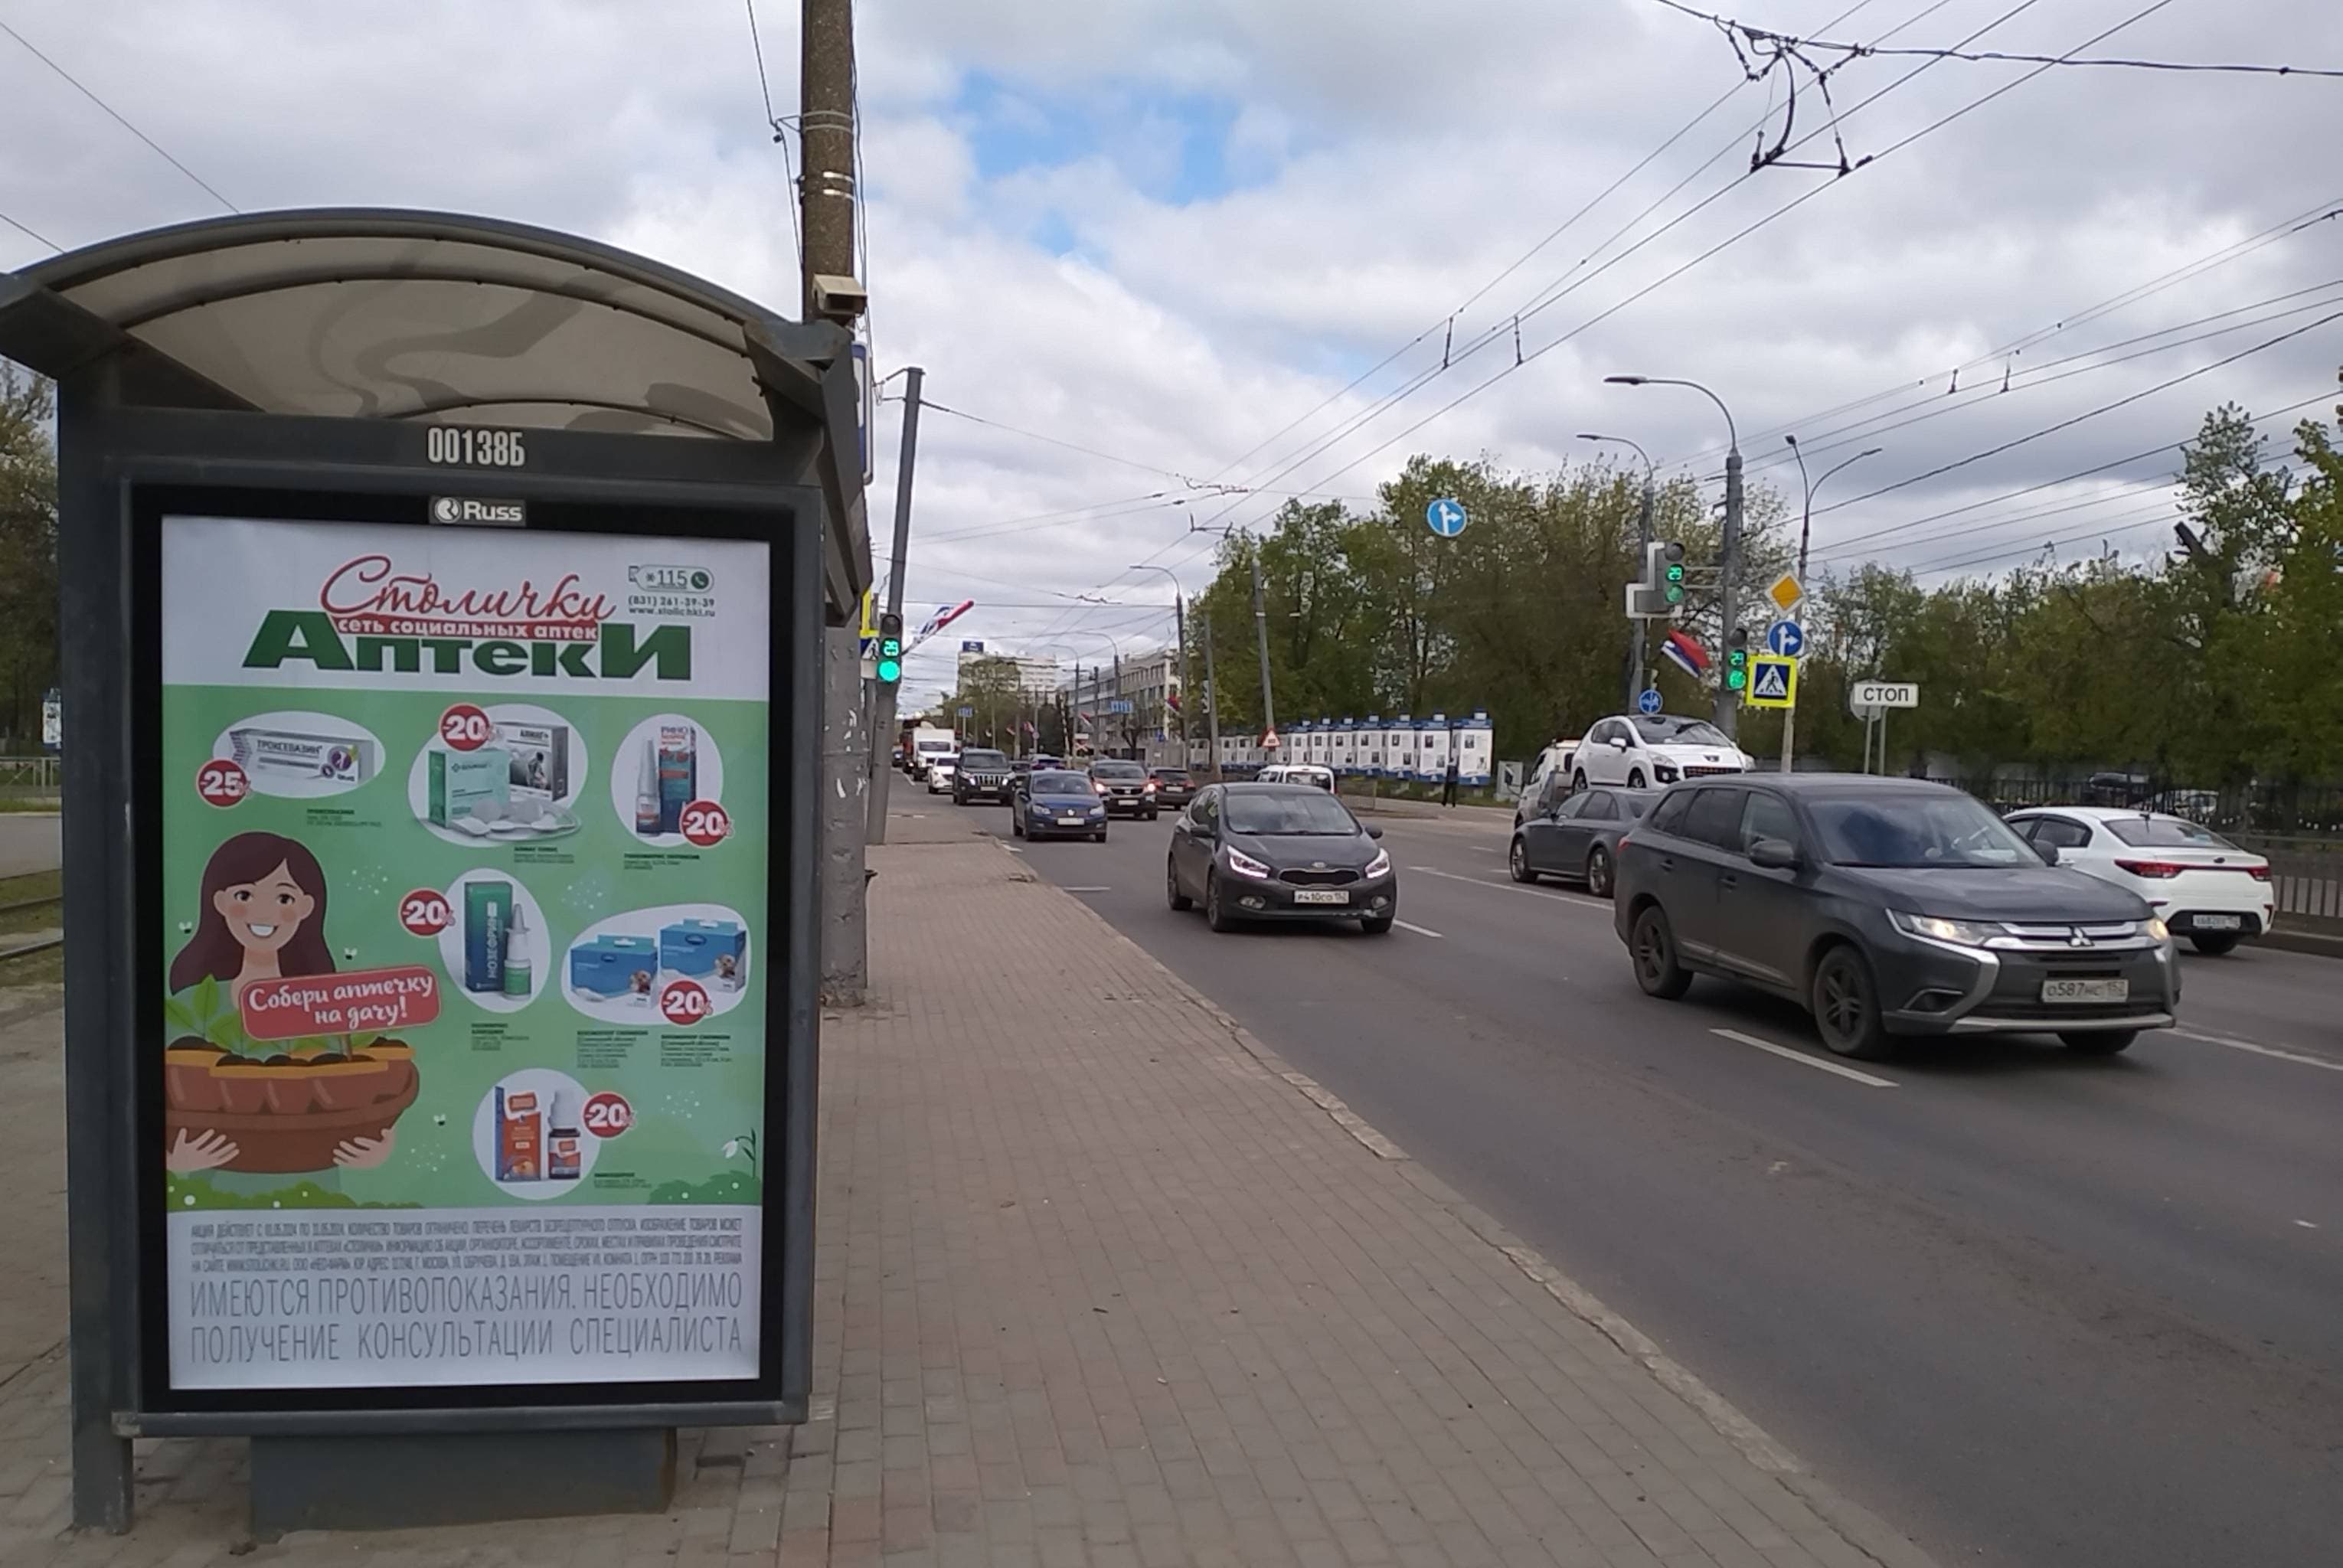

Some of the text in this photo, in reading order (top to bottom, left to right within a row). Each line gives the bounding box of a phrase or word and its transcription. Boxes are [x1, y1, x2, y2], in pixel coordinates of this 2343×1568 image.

[463, 500, 523, 521] Russ
[320, 555, 616, 620] Столички
[629, 596, 657, 606] (831)
[338, 618, 598, 640] сеть социальных аптек
[1863, 687, 1909, 701] СТОП
[249, 975, 433, 1012] Собери аптечку
[315, 996, 407, 1030] на дачу!
[191, 1272, 742, 1318] ИМЕЮТСЯ ПРОТИВОПОКАЗАНИЯ. НЕОБХОДИМО
[191, 1316, 742, 1364] ПОЛУЧЕНИЕ КОНСУЛЬТАЦИИ СПЕЦИАЛИСТА
